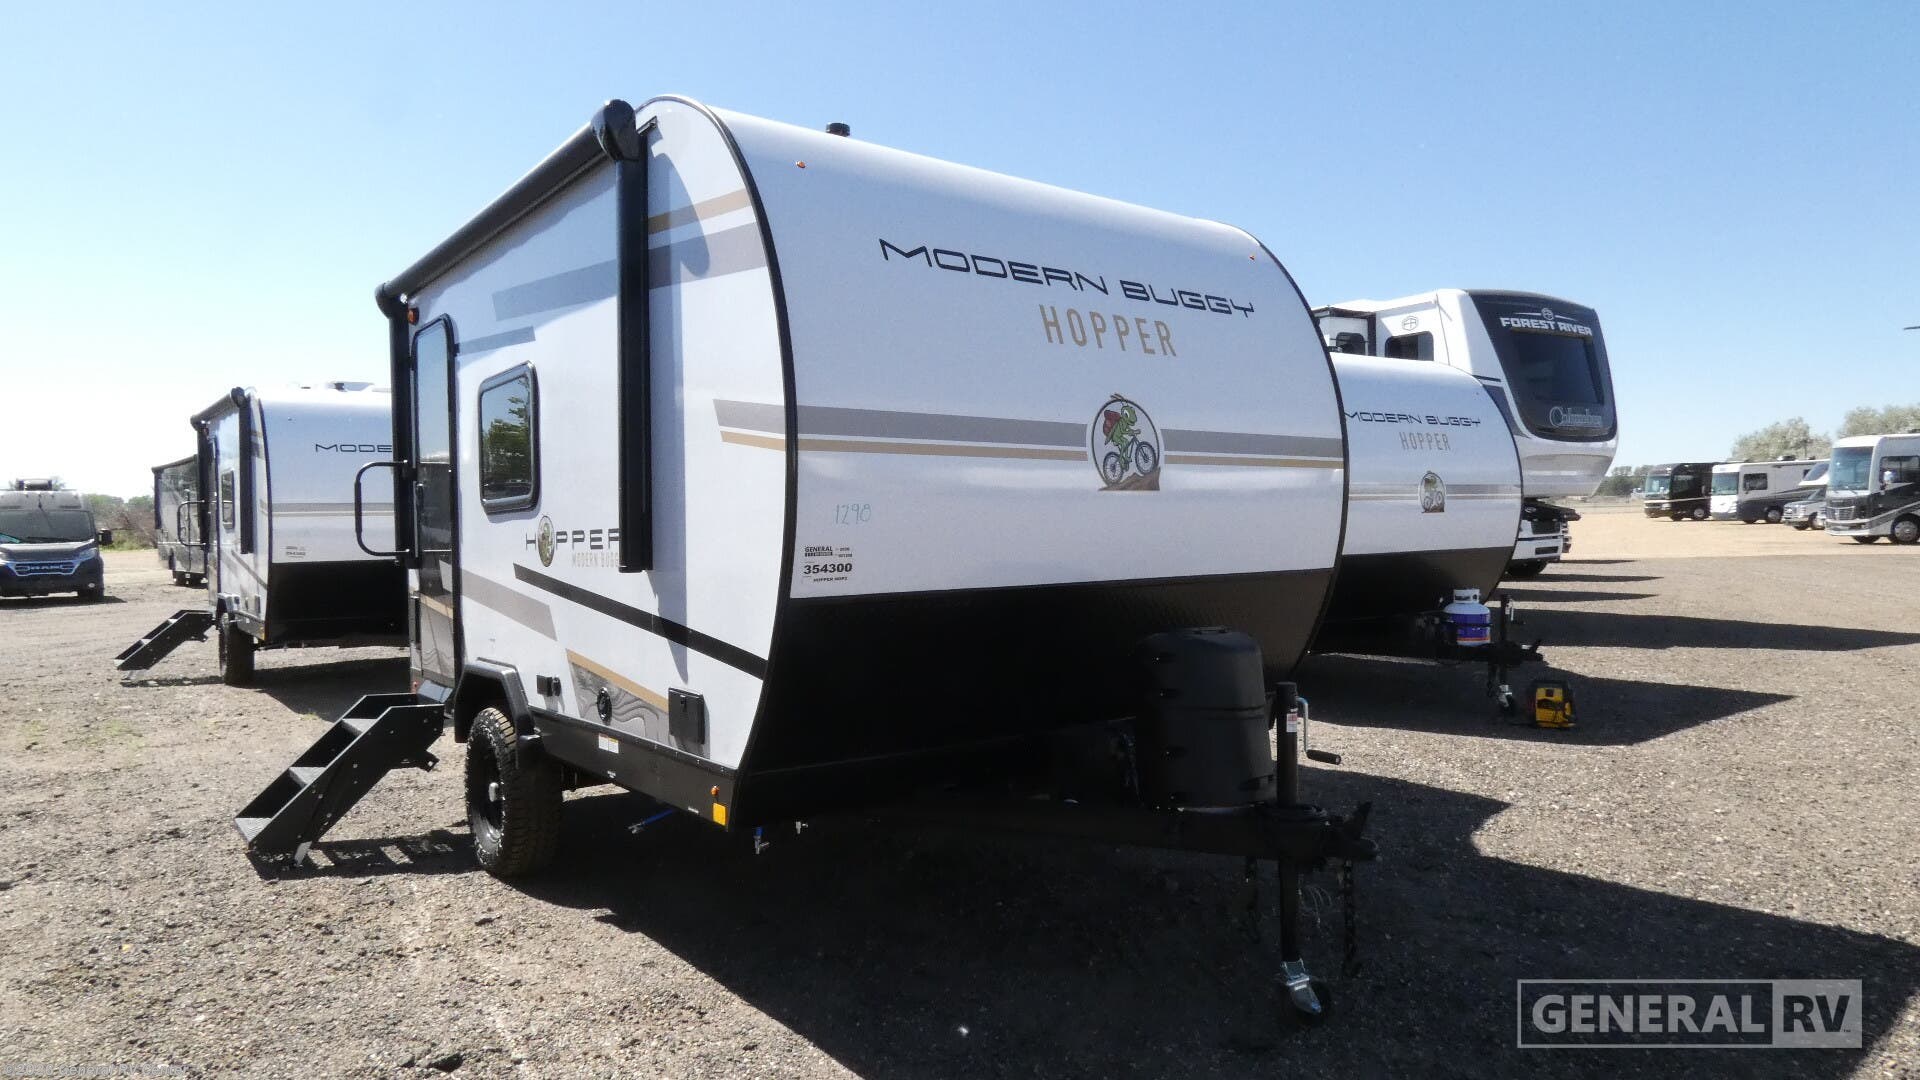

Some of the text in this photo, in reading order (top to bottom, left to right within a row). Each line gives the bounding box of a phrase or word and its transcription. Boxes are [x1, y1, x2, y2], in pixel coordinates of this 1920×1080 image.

[879, 238, 1254, 318] MODERN BUGGY
[1039, 304, 1177, 357] HOPPER
[1500, 317, 1593, 336] FOREST RIVER
[1344, 412, 1480, 428] MODERN BUGGY
[315, 443, 392, 453] MODE
[1399, 431, 1451, 450] HOPPER
[803, 562, 853, 575] 354300
